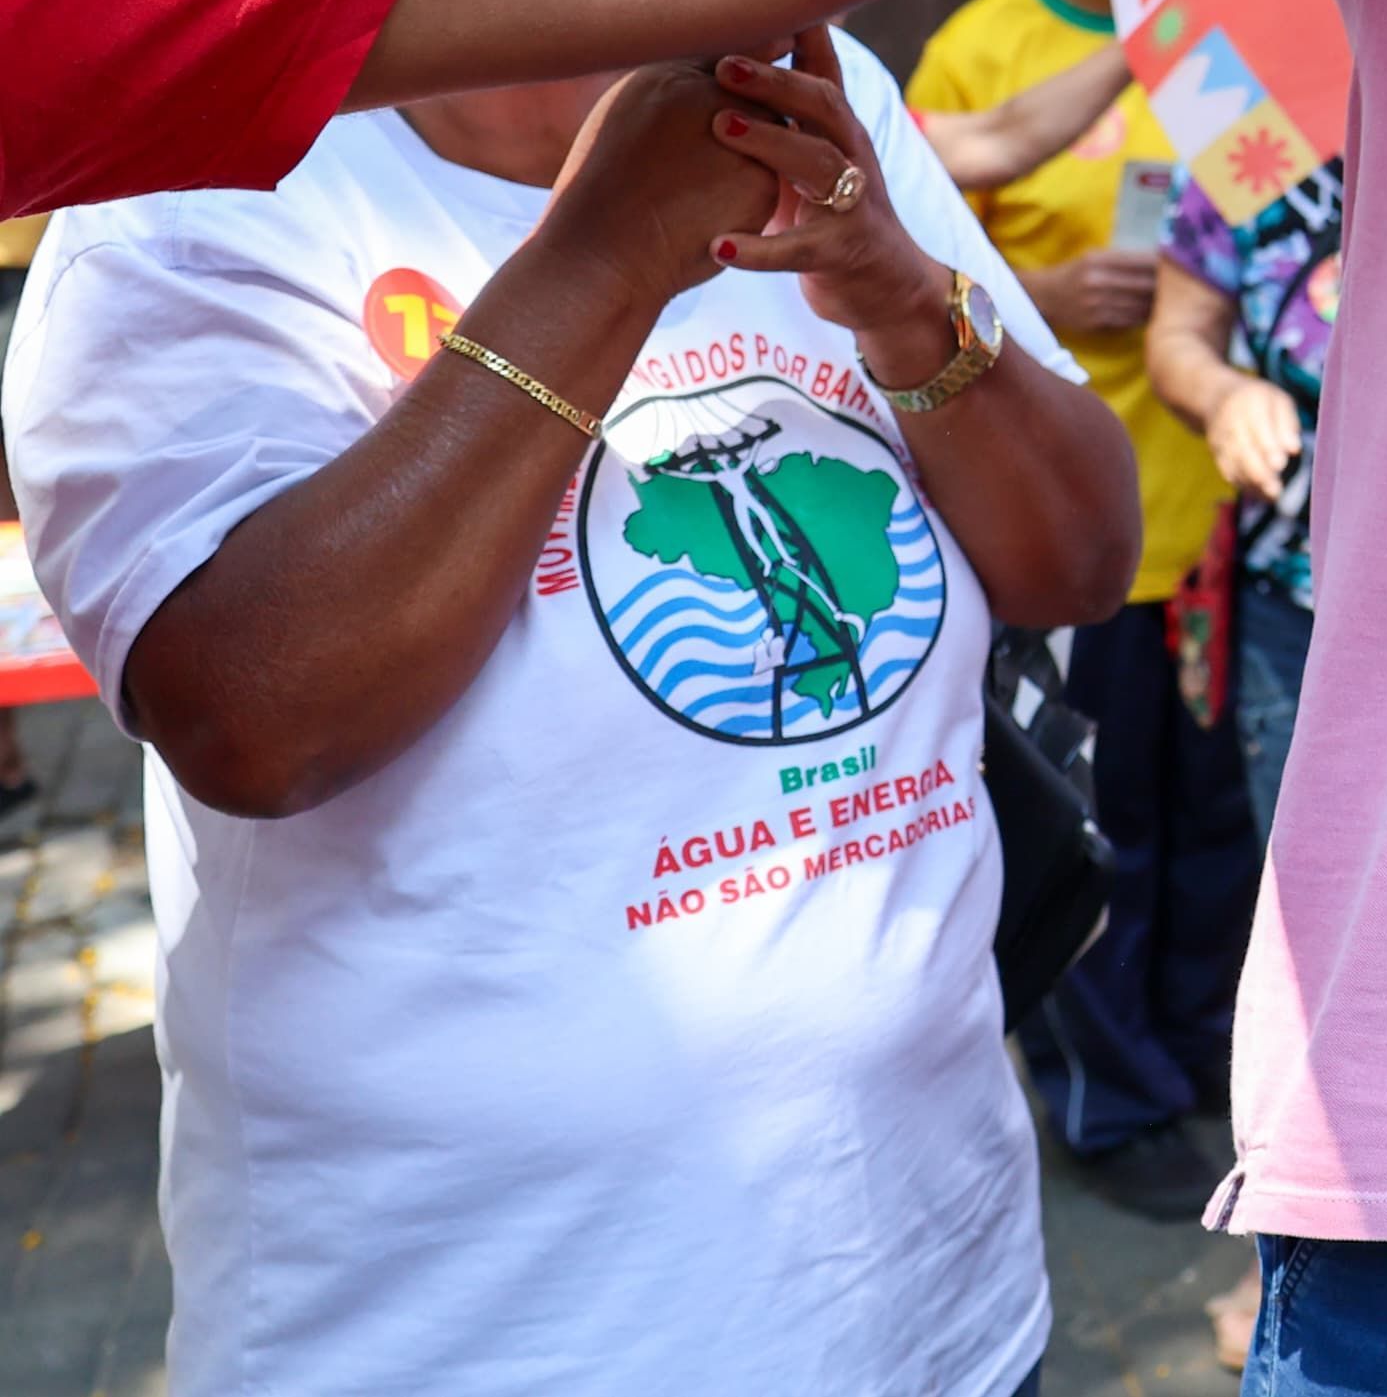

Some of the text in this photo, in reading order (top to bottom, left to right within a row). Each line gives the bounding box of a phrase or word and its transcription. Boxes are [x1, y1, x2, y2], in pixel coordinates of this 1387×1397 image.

[755, 333, 807, 384] POR
[779, 745, 876, 795] Brasil
[652, 820, 776, 880] ÁGUA
[788, 807, 817, 840] E
[625, 889, 705, 932] NÃO
[719, 865, 791, 906] SÃO
